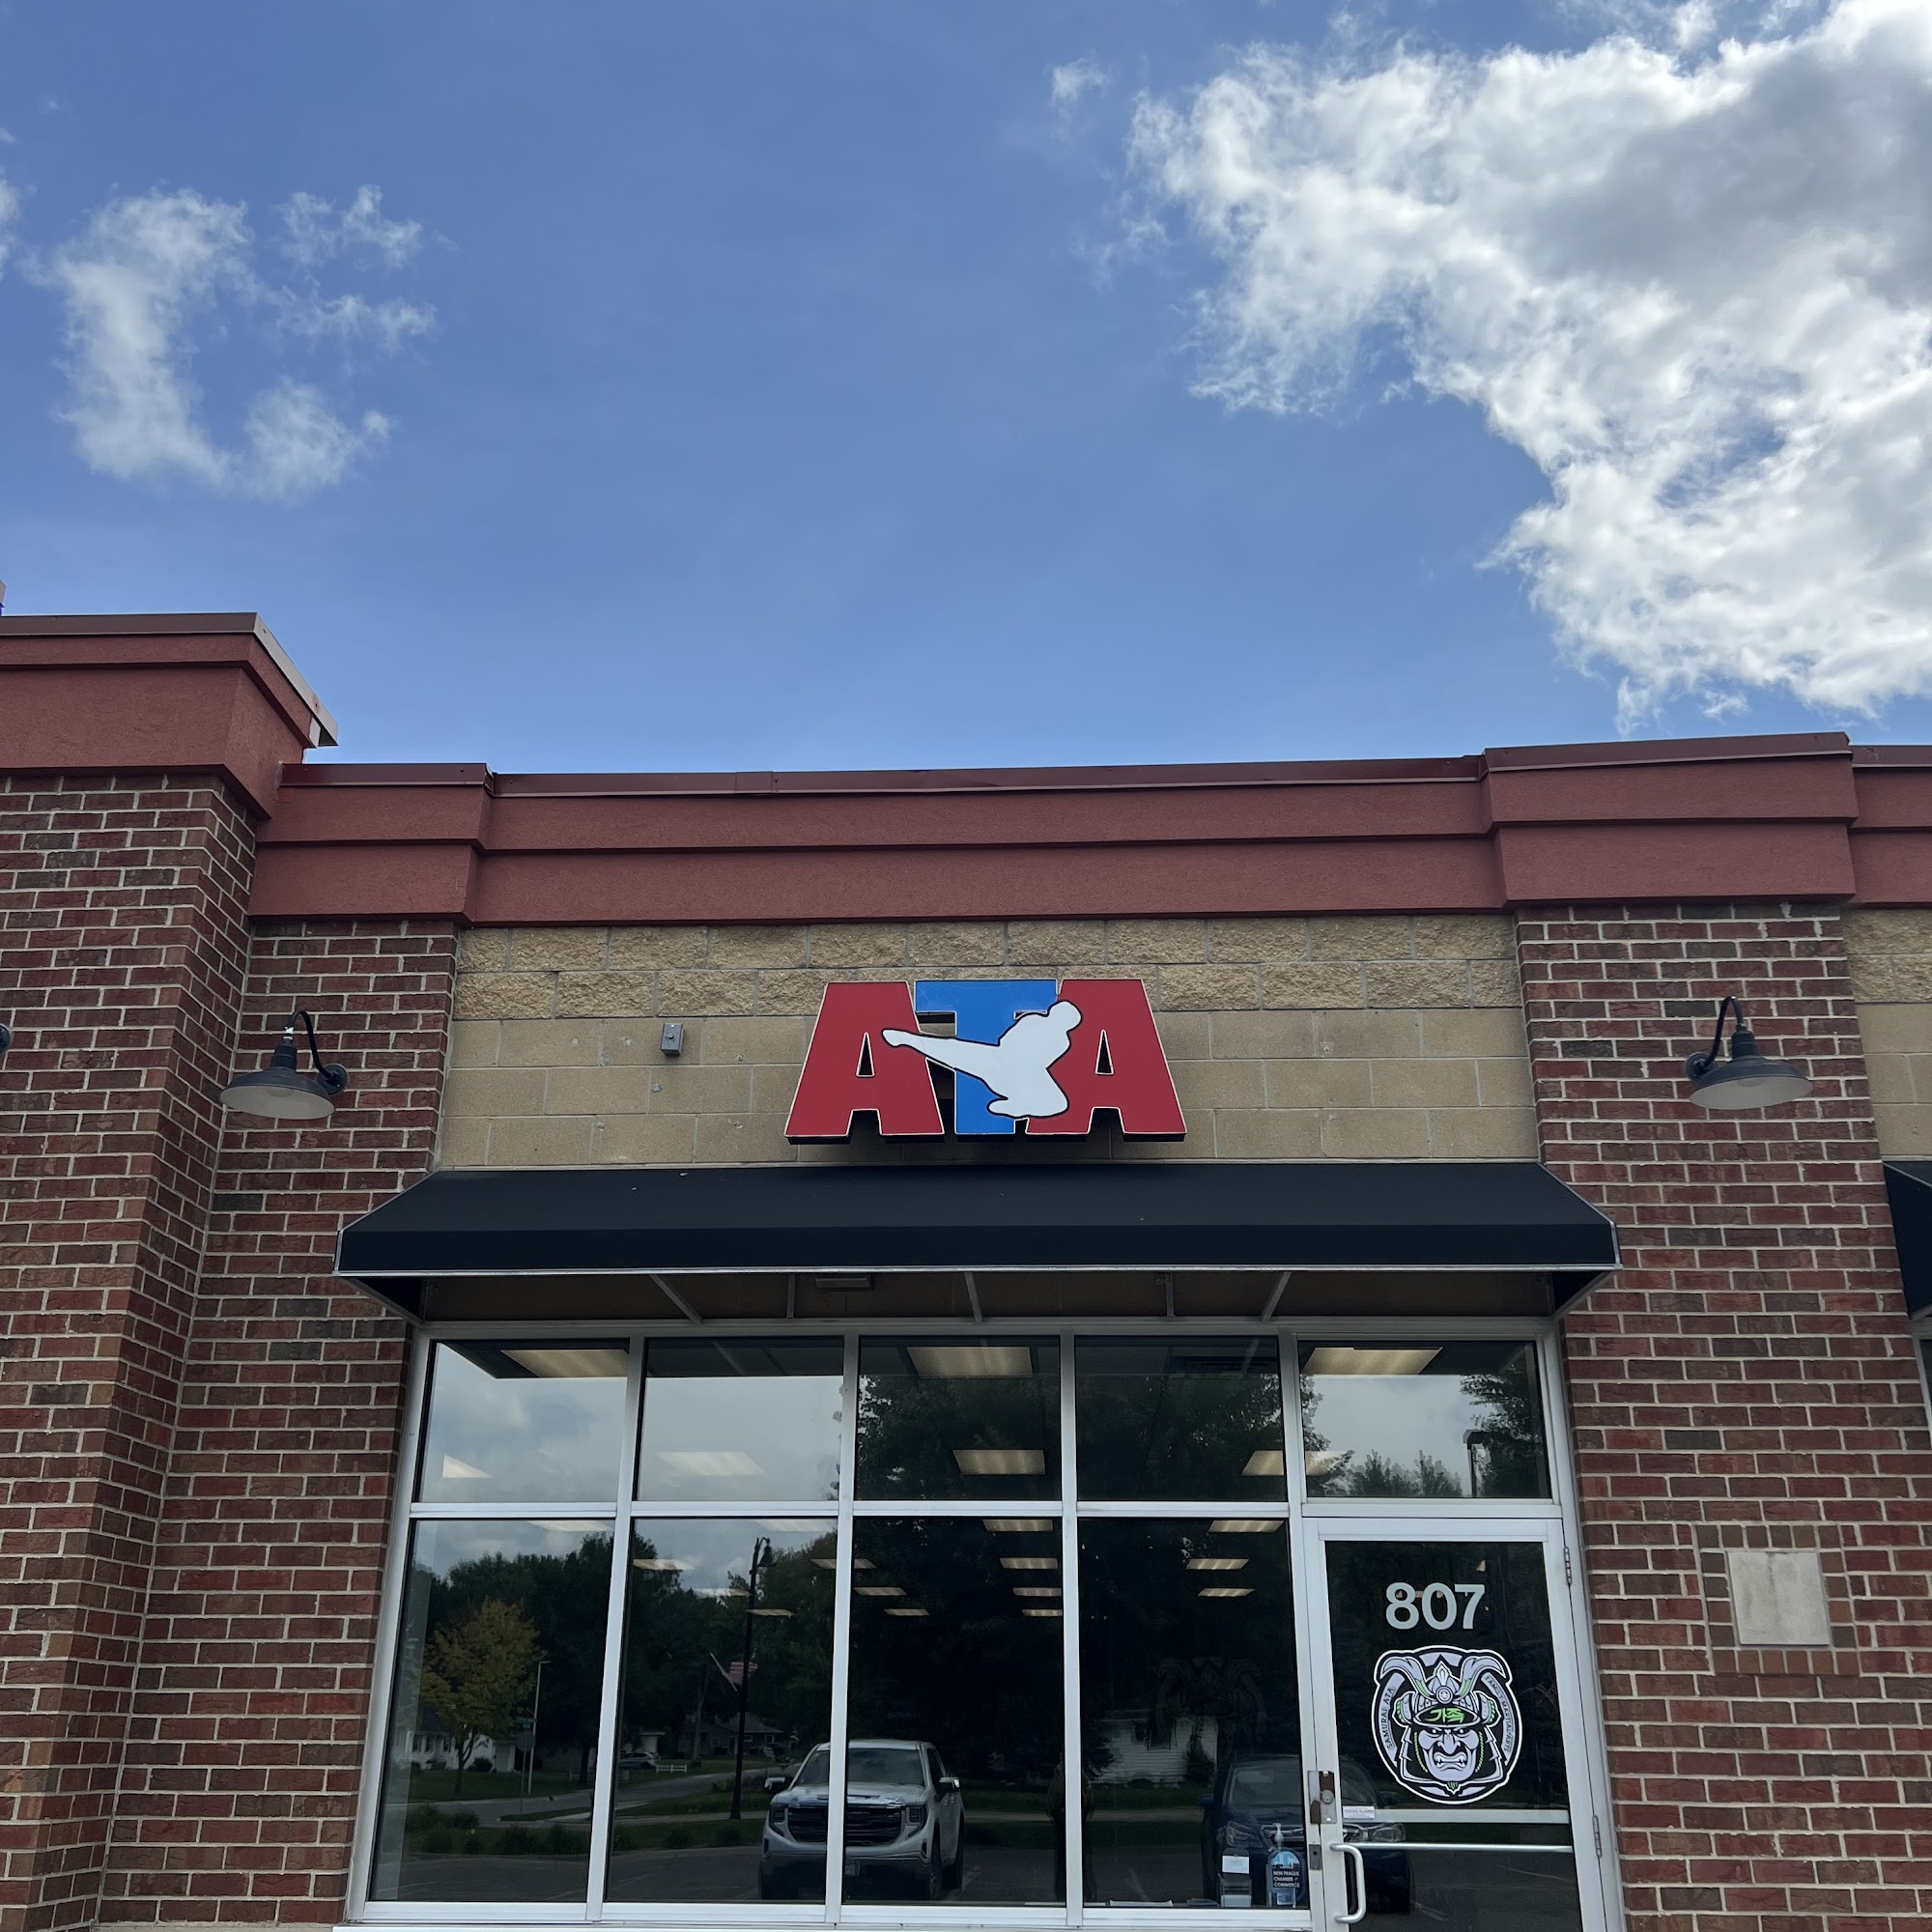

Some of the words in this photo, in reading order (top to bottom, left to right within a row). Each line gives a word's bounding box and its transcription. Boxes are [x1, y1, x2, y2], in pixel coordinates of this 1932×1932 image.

[785, 979, 1187, 1138] ATA
[1385, 1582, 1485, 1630] 807
[1383, 1688, 1396, 1705] ATA
[1381, 1708, 1393, 1749] SAMURAI
